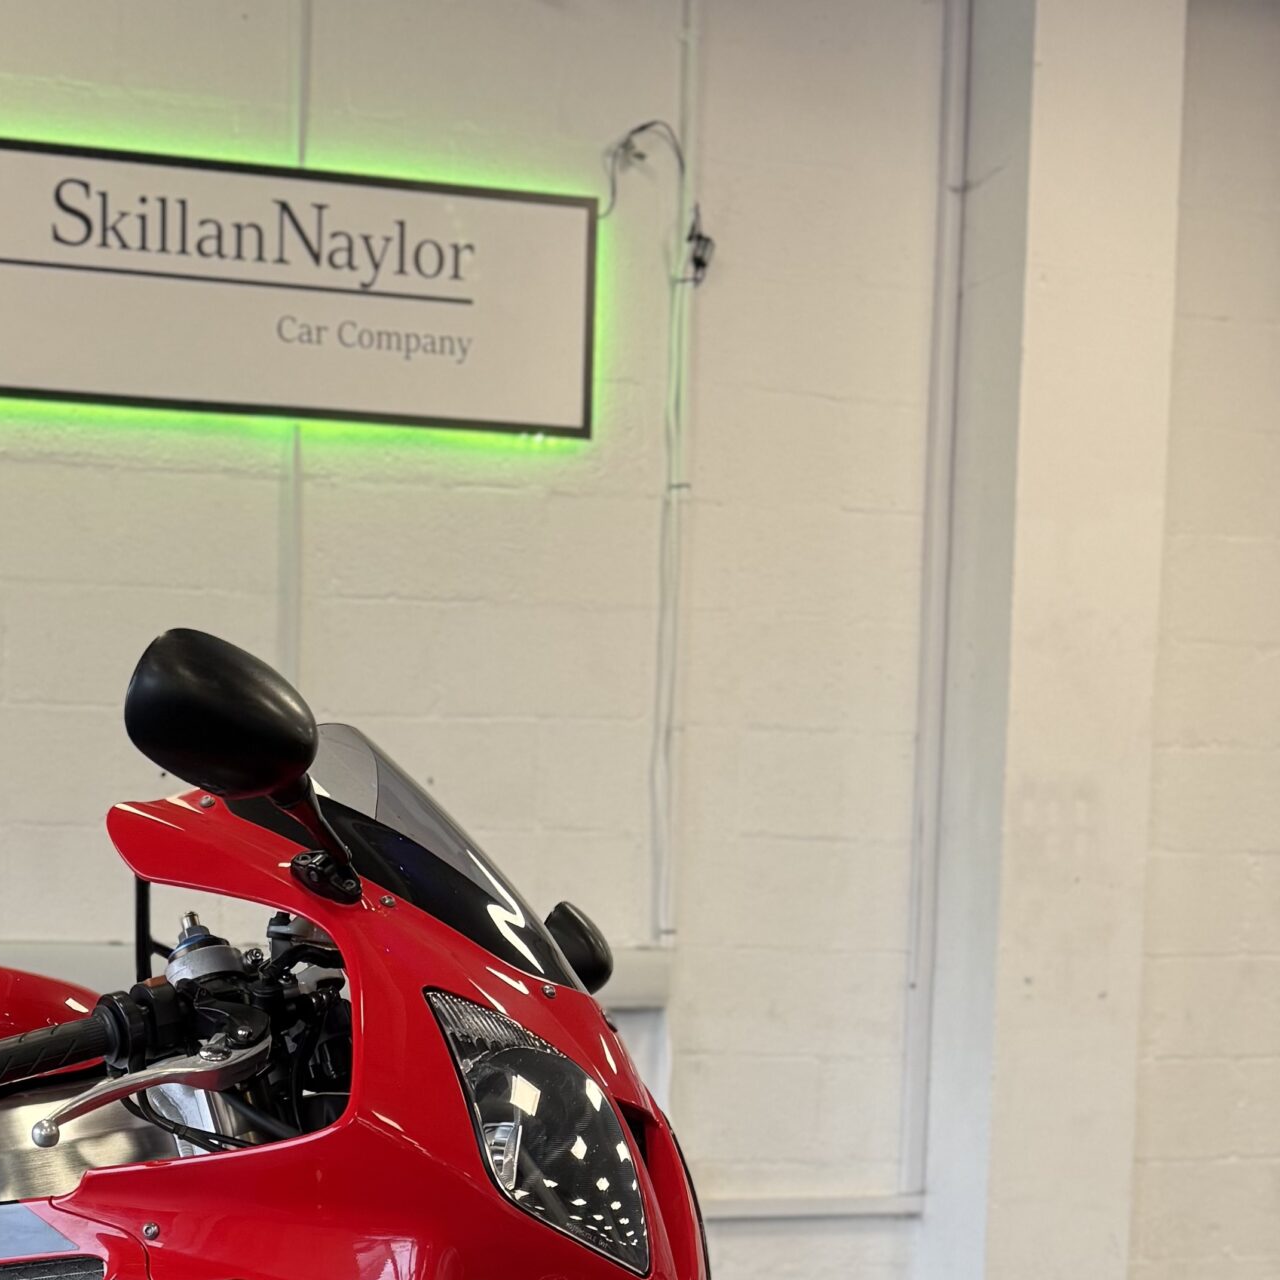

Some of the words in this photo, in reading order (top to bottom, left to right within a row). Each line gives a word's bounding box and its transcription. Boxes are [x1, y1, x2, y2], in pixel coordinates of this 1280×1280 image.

[49, 177, 476, 291] SkillanNaylor
[275, 316, 328, 346] Car
[336, 322, 473, 362] Company
